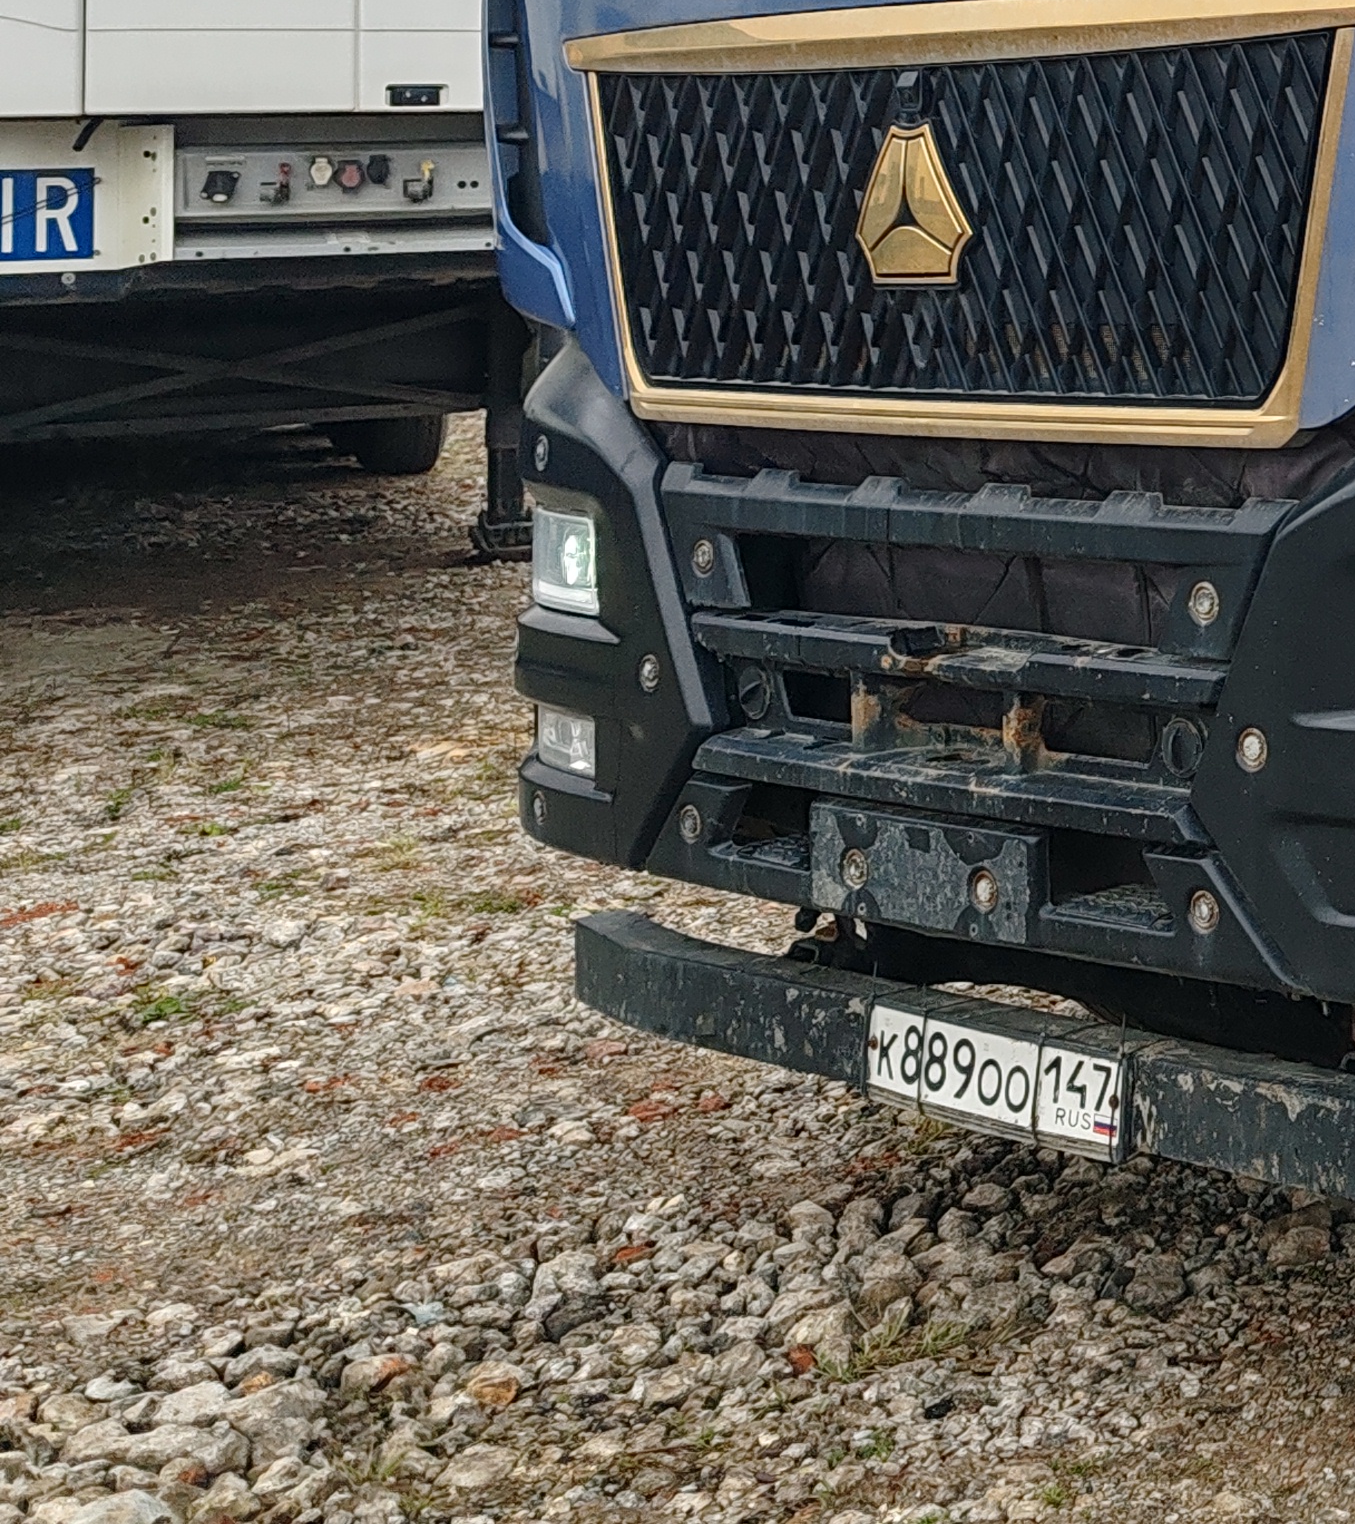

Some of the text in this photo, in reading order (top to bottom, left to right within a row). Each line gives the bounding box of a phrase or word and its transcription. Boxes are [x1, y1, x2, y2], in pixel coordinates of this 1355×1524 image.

[1, 177, 79, 254] IR
[1044, 1055, 1112, 1113] 147
[1054, 1107, 1092, 1131] RUS
